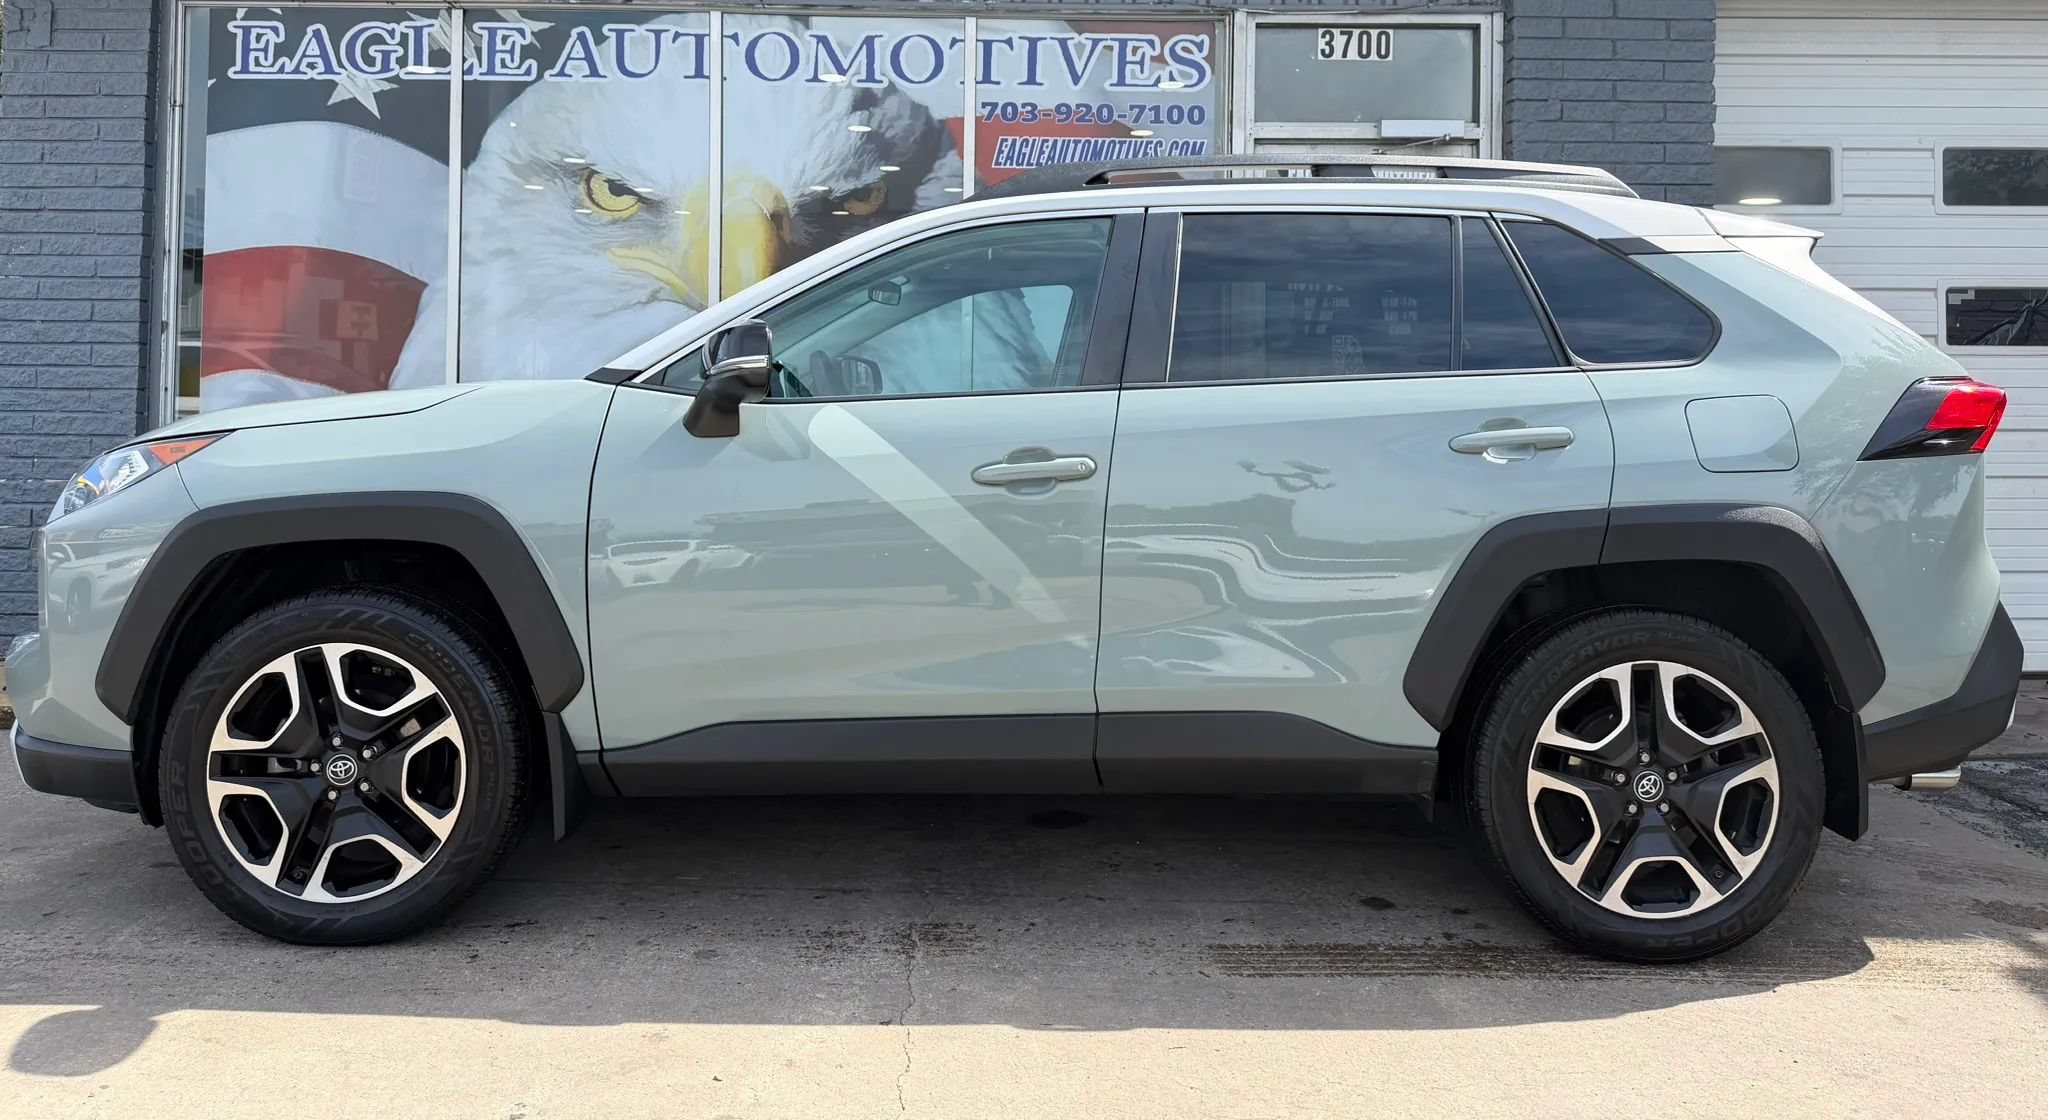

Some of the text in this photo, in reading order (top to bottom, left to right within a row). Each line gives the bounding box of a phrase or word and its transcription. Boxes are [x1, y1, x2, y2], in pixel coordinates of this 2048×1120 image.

[230, 22, 1211, 89] EAGLE AUTOMOTIVES
[1319, 29, 1391, 60] 3700
[980, 101, 1207, 126] 703-920-7100
[992, 135, 1207, 169] EAGLEAUTOMOTIVESCOM
